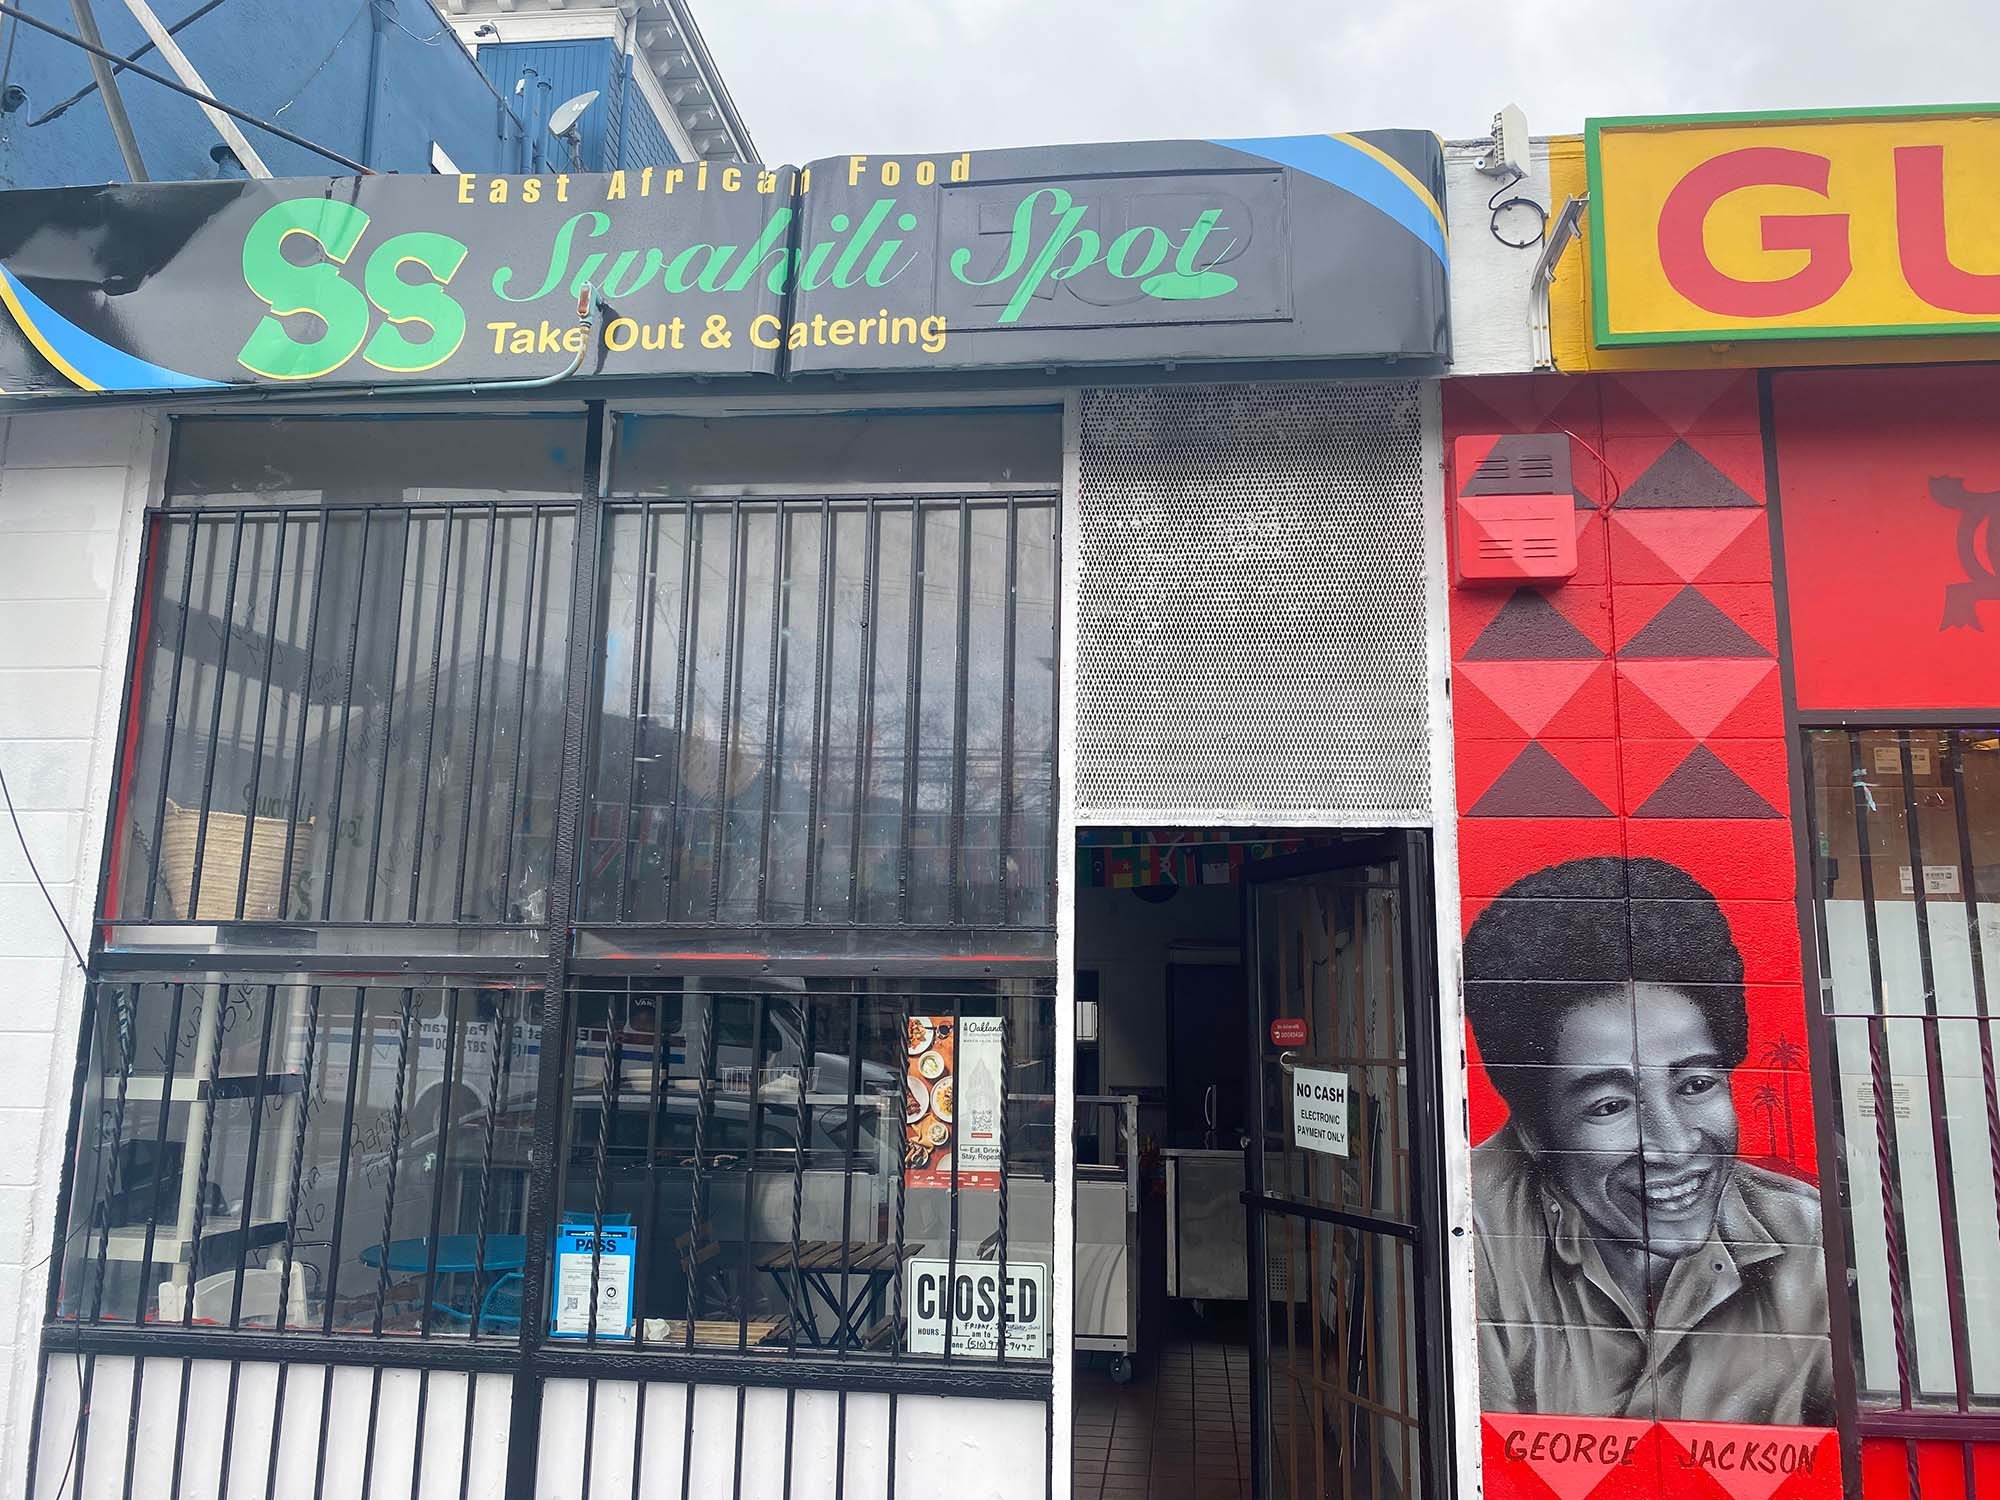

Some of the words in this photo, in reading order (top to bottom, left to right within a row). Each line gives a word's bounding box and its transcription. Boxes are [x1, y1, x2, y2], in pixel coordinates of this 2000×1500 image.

[459, 173, 568, 204] East
[607, 160, 811, 201] African
[848, 153, 972, 186] Food
[492, 198, 918, 303] Swahili
[950, 187, 1237, 323] Spot
[486, 320, 582, 354] Take
[603, 316, 685, 352] Out
[700, 314, 732, 350] &
[750, 308, 947, 354] Catering
[1296, 1082, 1311, 1098] NO
[1314, 1085, 1345, 1103] CASH
[1300, 1109, 1341, 1125] ELECTRONIC
[1297, 1125, 1326, 1139] PAYMENT
[1327, 1129, 1345, 1143] ONLY
[575, 1238, 617, 1252] PASS
[917, 1273, 1037, 1323] CLOSED
[917, 1328, 940, 1336] HOURS
[1504, 1430, 1638, 1466] GEORGE
[1677, 1439, 1817, 1475] JACKSON
